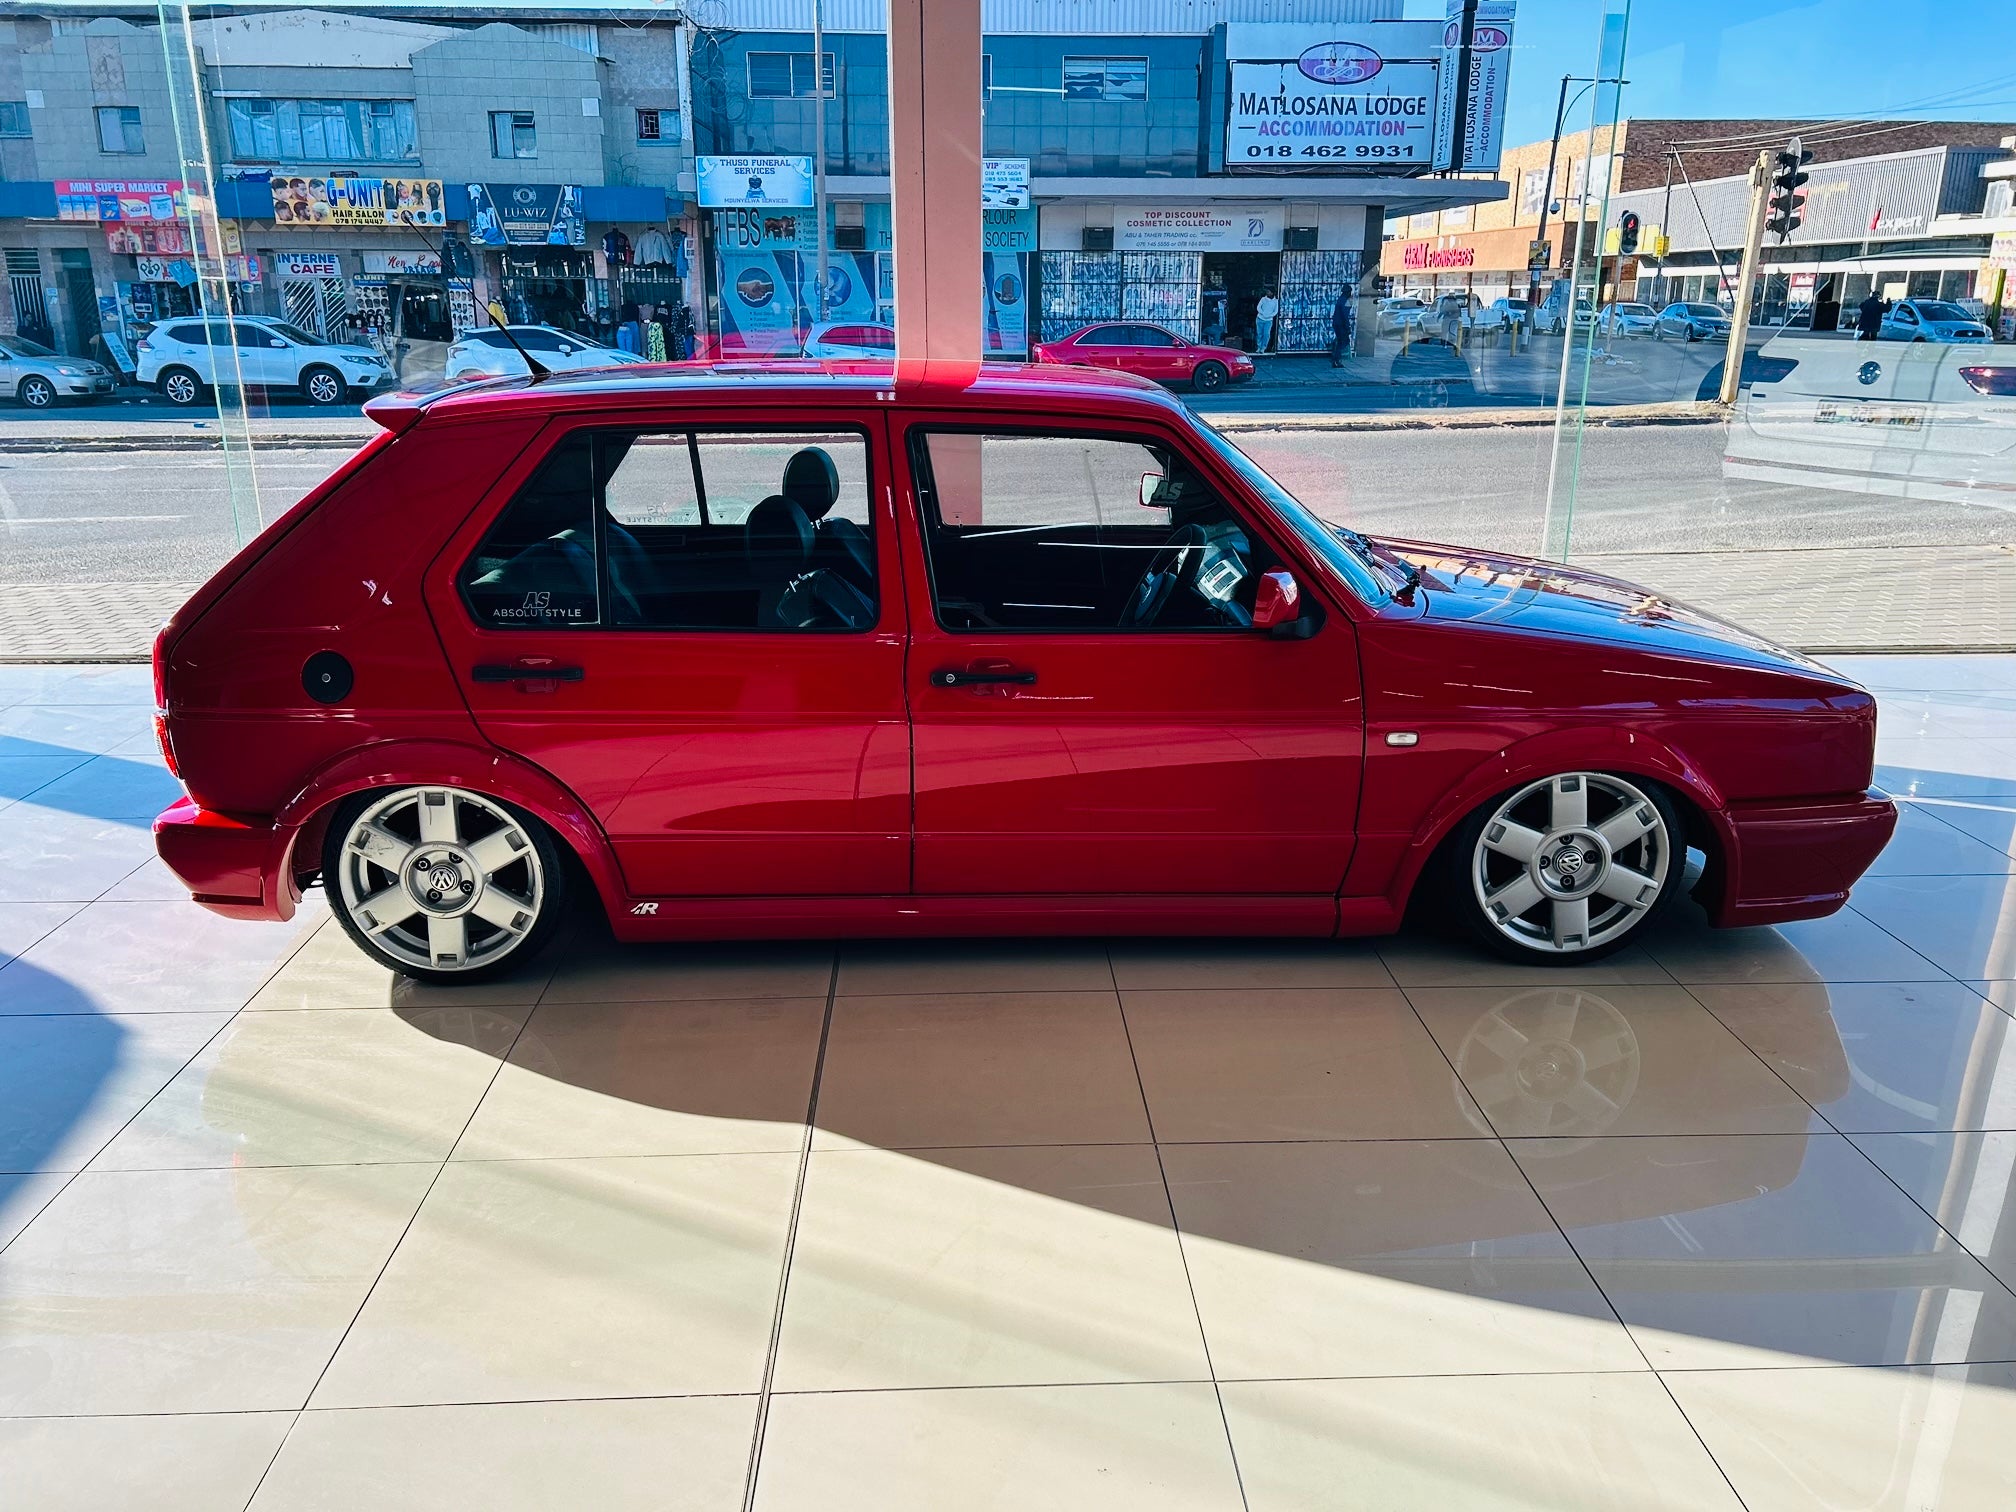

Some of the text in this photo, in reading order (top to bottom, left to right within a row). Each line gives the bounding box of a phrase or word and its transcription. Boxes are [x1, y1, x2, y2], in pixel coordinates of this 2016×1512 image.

[1239, 92, 1427, 116] MATLOSANA LODGE
[1464, 56, 1482, 163] MATLOSANA LODGE
[1480, 67, 1496, 152] ACCOMMODATION
[1258, 120, 1405, 137] ACCOMMODATION
[1247, 145, 1415, 158] 018 462 9931
[720, 159, 791, 167] THUSO FUNERAL
[734, 167, 776, 175] SERVICES
[69, 182, 168, 193] MINI SUPER MARKET
[325, 178, 385, 208] G-UNIT
[332, 209, 385, 219] HAIR SALON
[504, 207, 548, 218] LU-WIZ
[1144, 211, 1212, 219] TOP DISCOUNT
[713, 208, 761, 248] TFBS
[1175, 219, 1232, 227] COLLECTION
[985, 231, 1030, 248] SOCIETY
[277, 253, 340, 264] INTERNE
[1429, 247, 1475, 268] FURNISHERS
[291, 264, 335, 275] CAFE
[1151, 481, 1184, 500] AS
[523, 592, 550, 609] AS
[492, 608, 582, 618] ABSOLUTSTYLE
